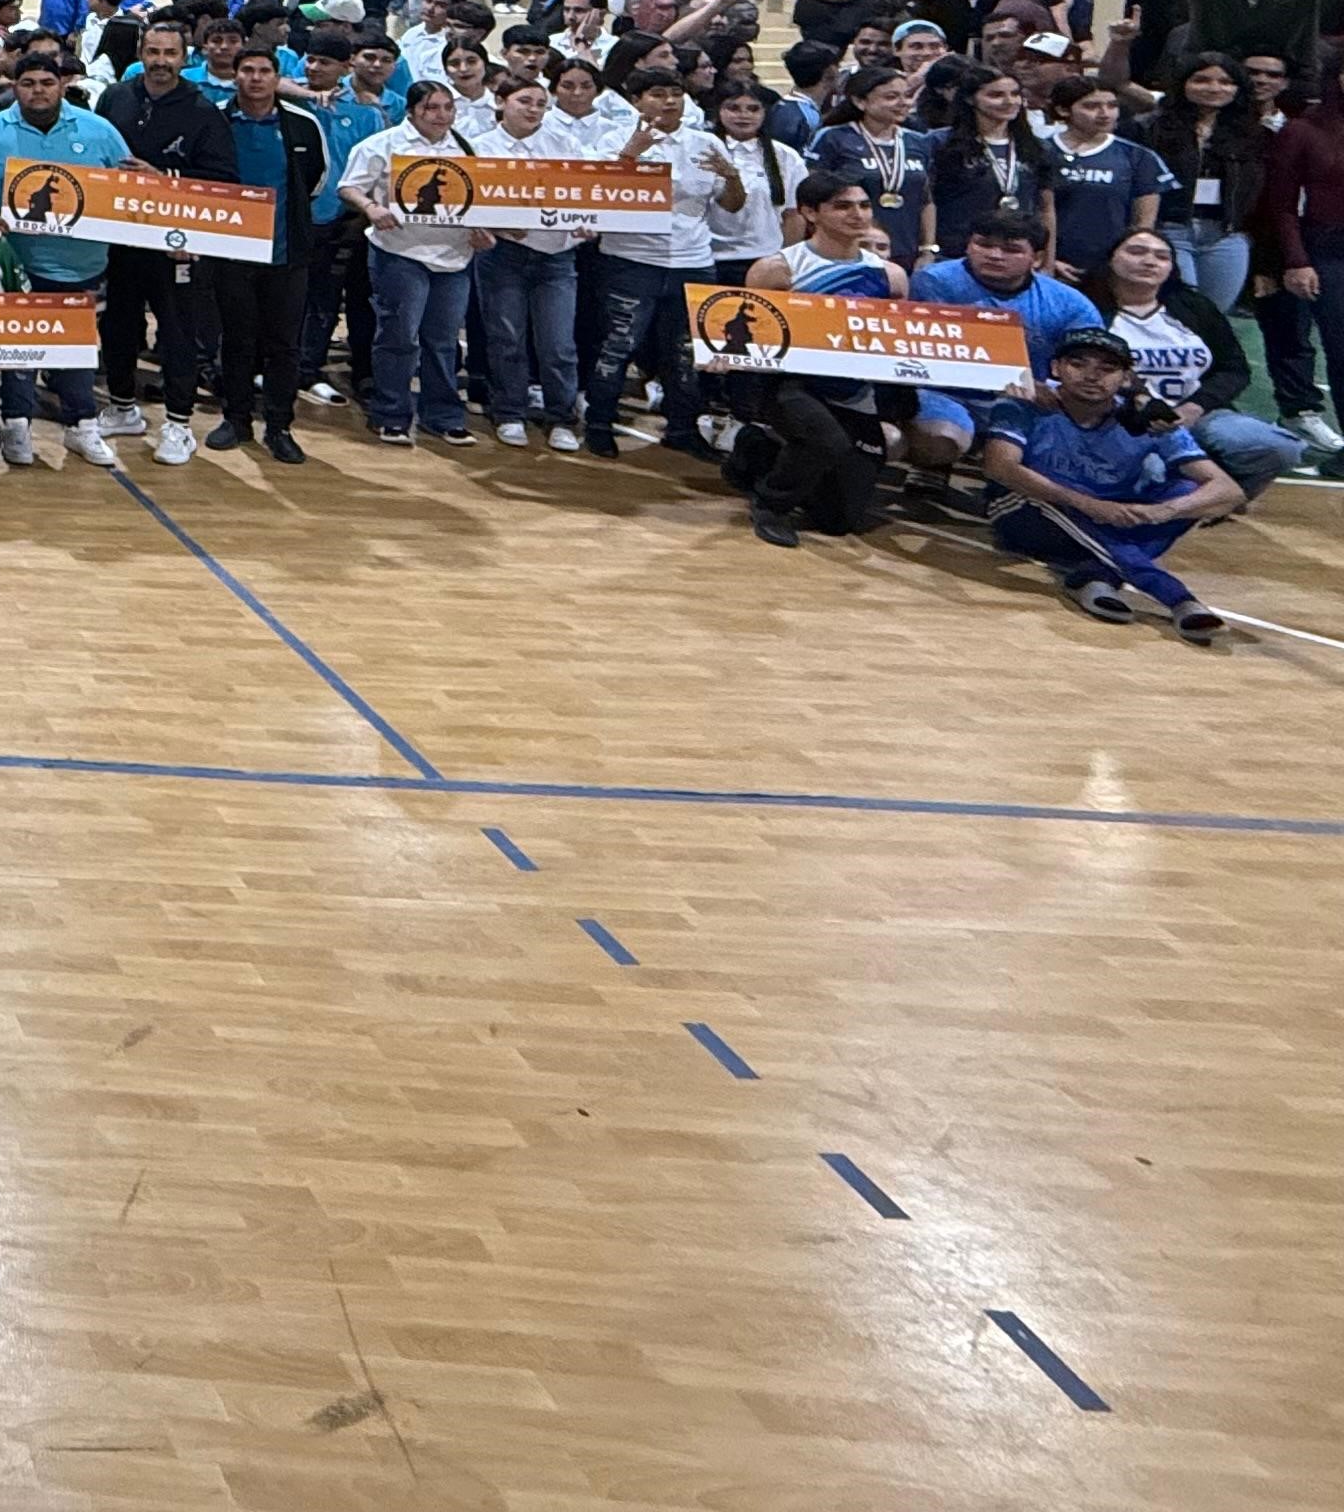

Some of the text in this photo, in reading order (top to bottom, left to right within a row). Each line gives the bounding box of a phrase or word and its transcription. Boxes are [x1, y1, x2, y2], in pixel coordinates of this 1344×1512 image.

[479, 184, 667, 203] VALLE DE ÉVORA
[113, 196, 244, 226] ESCUINAPA
[562, 213, 598, 225] UPVE
[848, 316, 963, 339] DEL MAR
[826, 333, 992, 362] Y LA SIERRA
